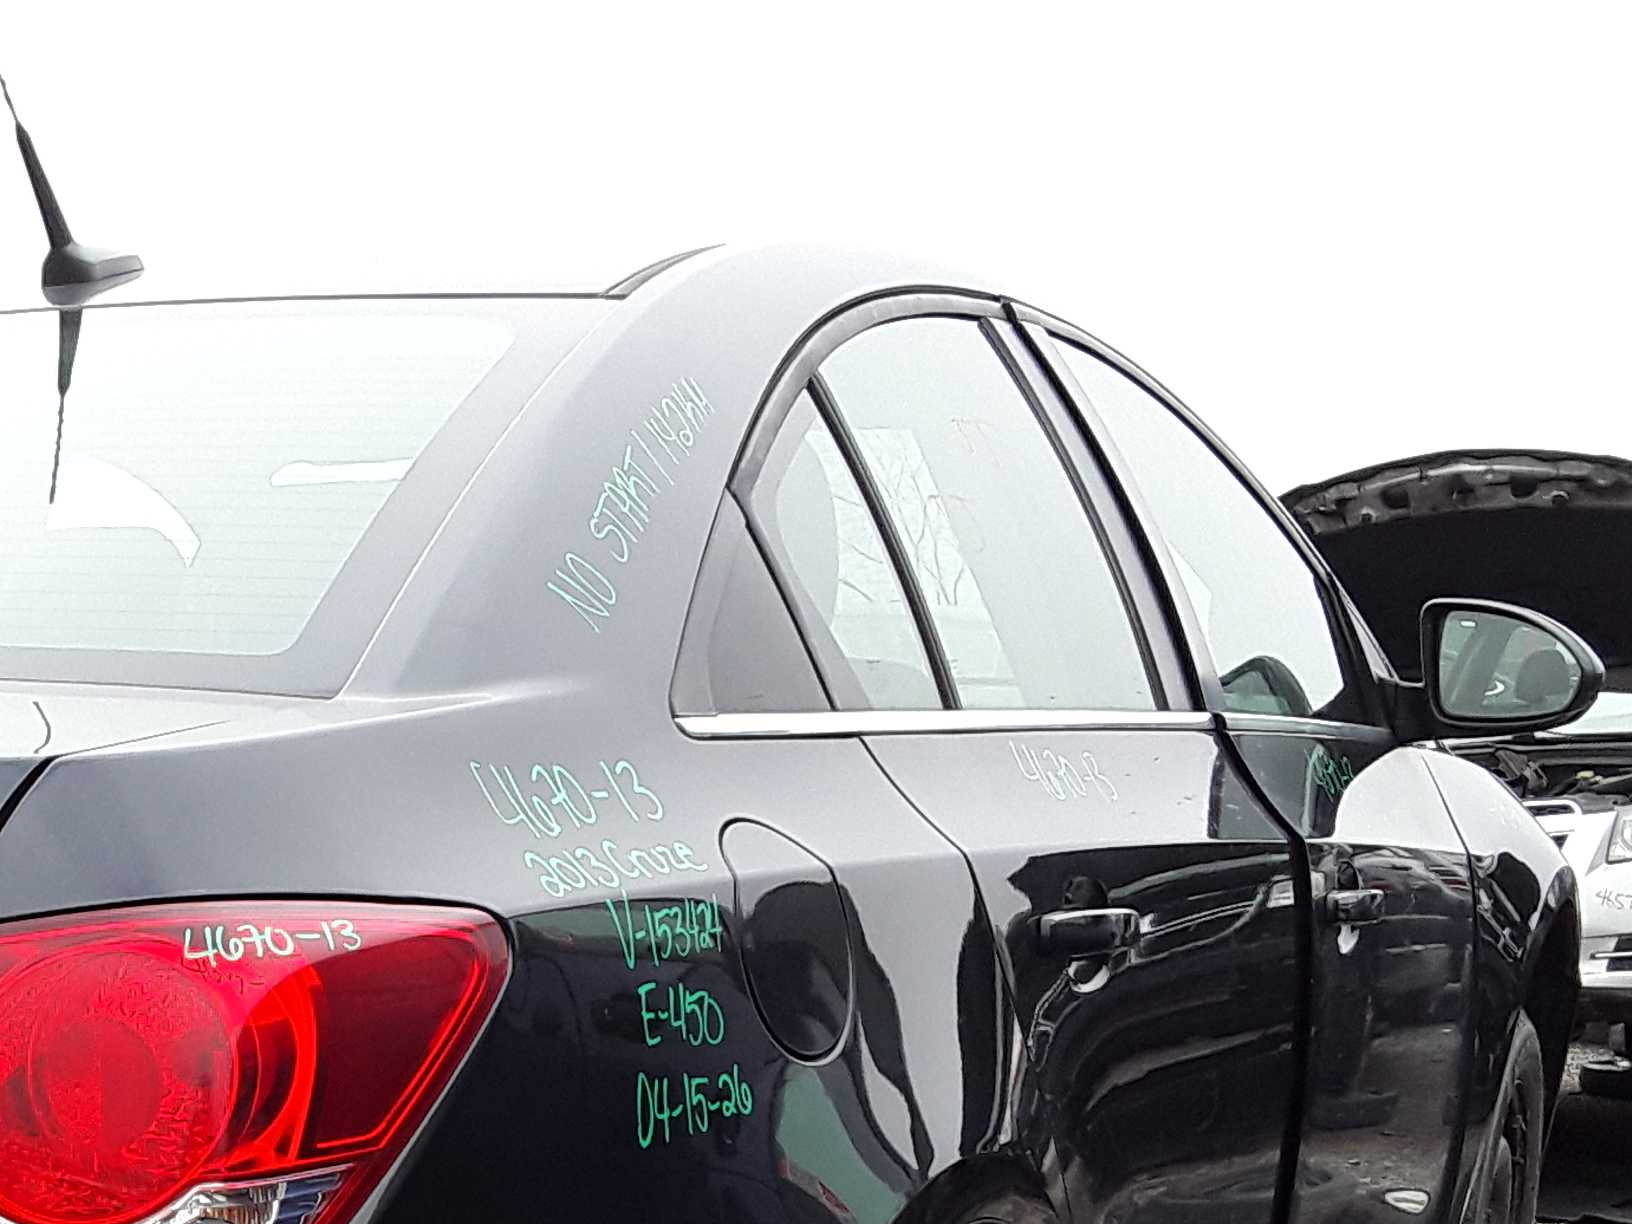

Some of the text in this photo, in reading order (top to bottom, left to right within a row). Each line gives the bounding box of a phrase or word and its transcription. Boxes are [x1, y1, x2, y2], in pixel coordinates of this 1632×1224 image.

[547, 552, 616, 633] NO
[470, 760, 664, 839] 4670-13
[183, 918, 362, 969] 4670-13
[606, 889, 722, 970] V-153424
[637, 982, 725, 1047] E-450
[636, 1064, 753, 1149] 04-15-26
